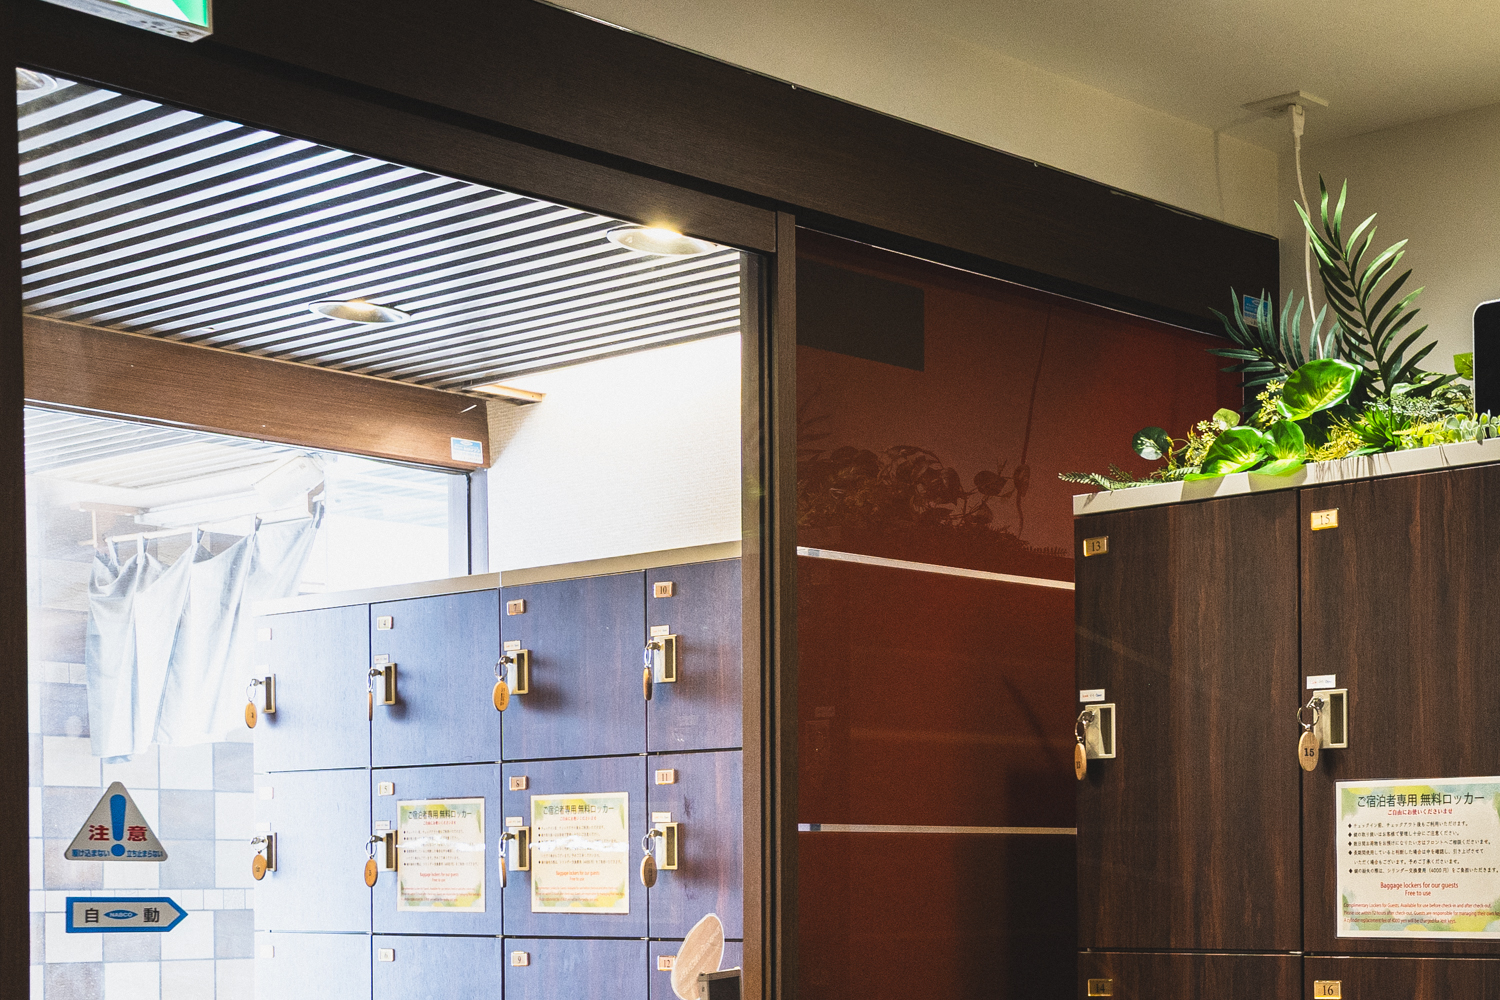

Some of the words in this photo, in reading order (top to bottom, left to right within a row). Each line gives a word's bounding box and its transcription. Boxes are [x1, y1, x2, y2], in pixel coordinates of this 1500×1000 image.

[1320, 514, 1330, 526] 15
[1092, 540, 1100, 552] 13
[660, 586, 667, 594] 10
[1304, 748, 1314, 757] 15
[662, 774, 668, 782] 11
[1358, 794, 1418, 808] ご宿泊者専用
[1420, 792, 1484, 806] 無料ロッカー
[1380, 882, 1402, 890] Baggage
[518, 956, 522, 964] 9
[1096, 984, 1105, 993] 14
[1322, 984, 1334, 996] 16
